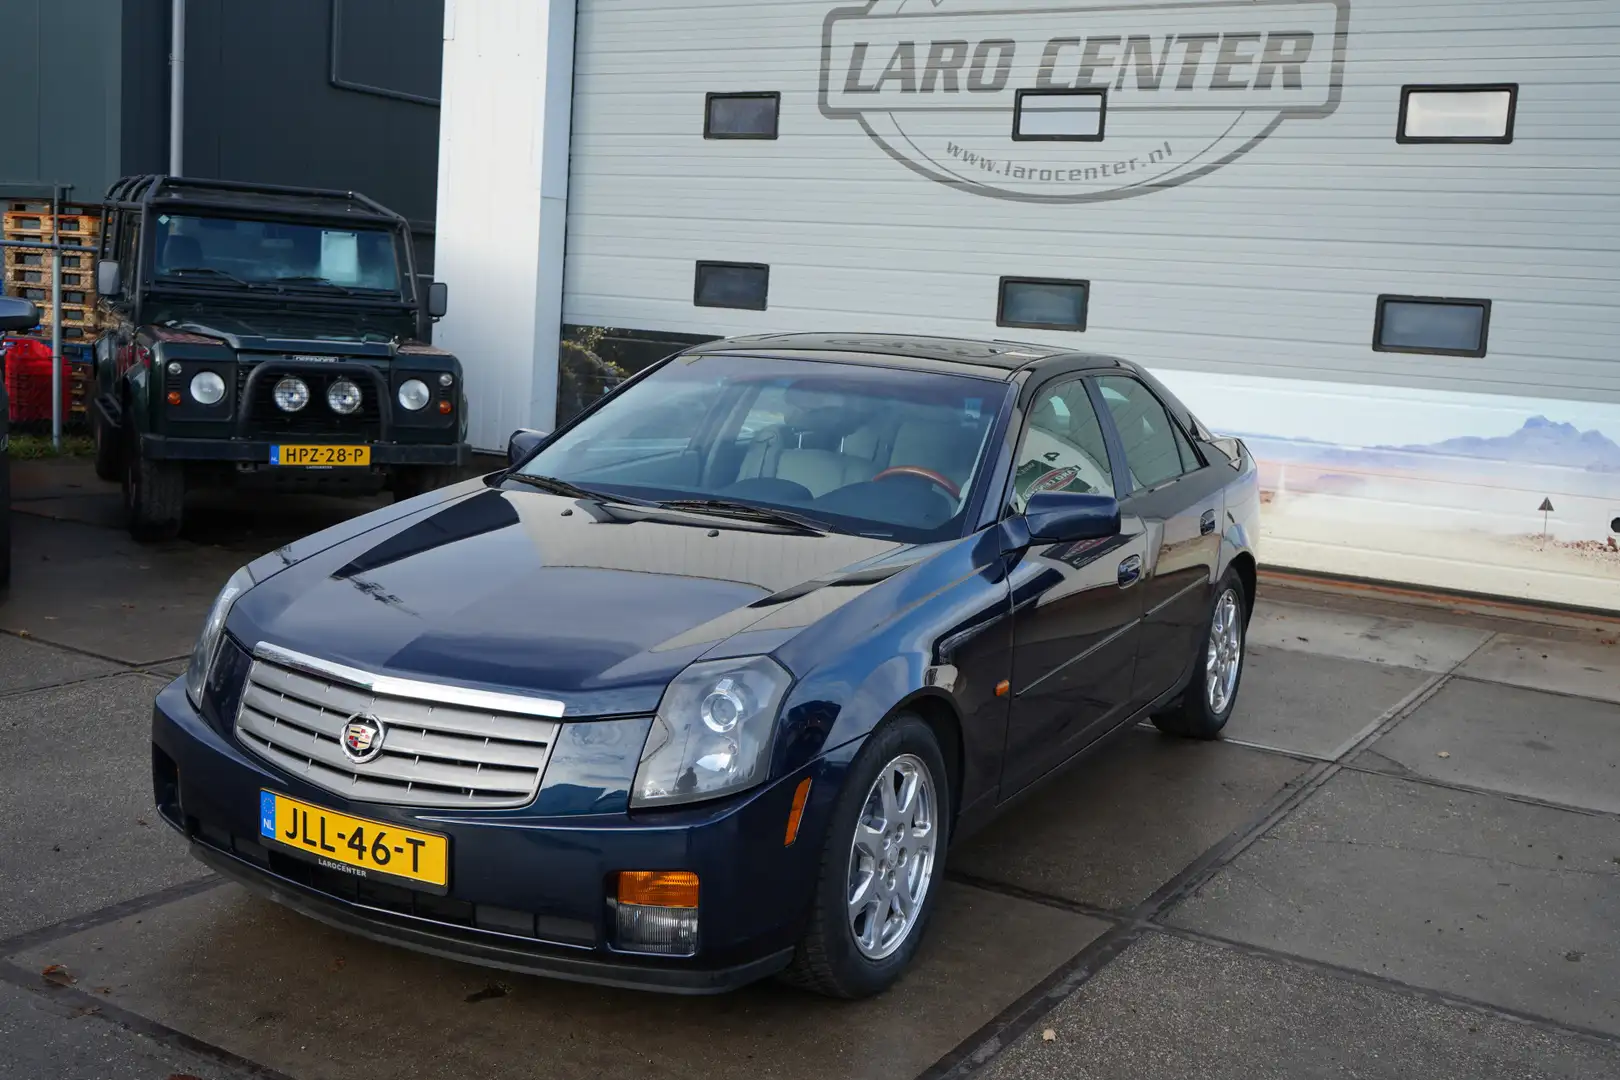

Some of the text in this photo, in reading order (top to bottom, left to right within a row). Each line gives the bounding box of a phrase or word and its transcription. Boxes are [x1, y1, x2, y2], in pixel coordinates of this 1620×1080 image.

[843, 31, 1314, 94] LARO CENTER
[946, 141, 1173, 182] www.larocenter.nl
[286, 447, 363, 462] HPZ-28-P
[263, 817, 275, 831] NL
[285, 807, 426, 873] JLL-46-T
[318, 858, 367, 878] LAROCENTER
